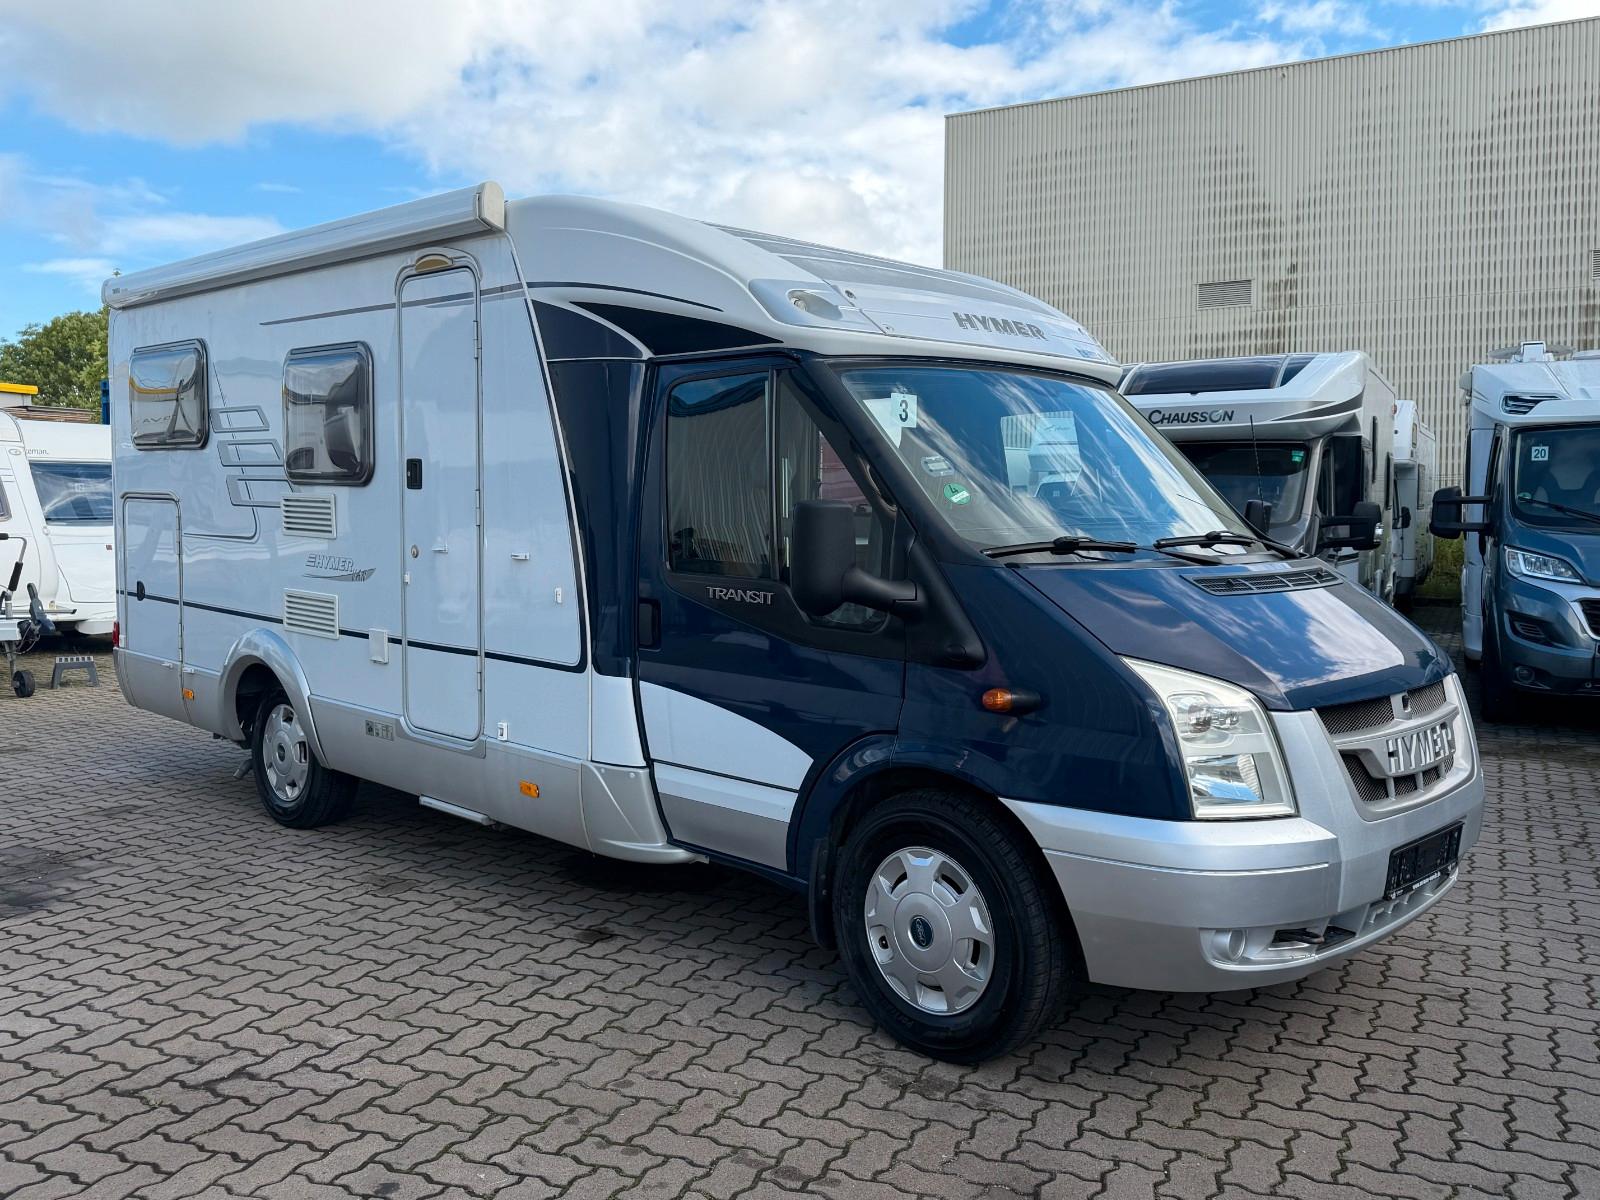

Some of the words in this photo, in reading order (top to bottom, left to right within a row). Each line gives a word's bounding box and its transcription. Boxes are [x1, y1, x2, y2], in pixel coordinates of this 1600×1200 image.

[952, 311, 1049, 342] HYMER
[898, 399, 909, 423] 3
[1148, 409, 1235, 425] CHAUSSON
[1533, 448, 1547, 459] 20
[315, 554, 354, 573] HYMER
[705, 586, 775, 605] TRANSIT
[1386, 721, 1456, 774] HYMER
